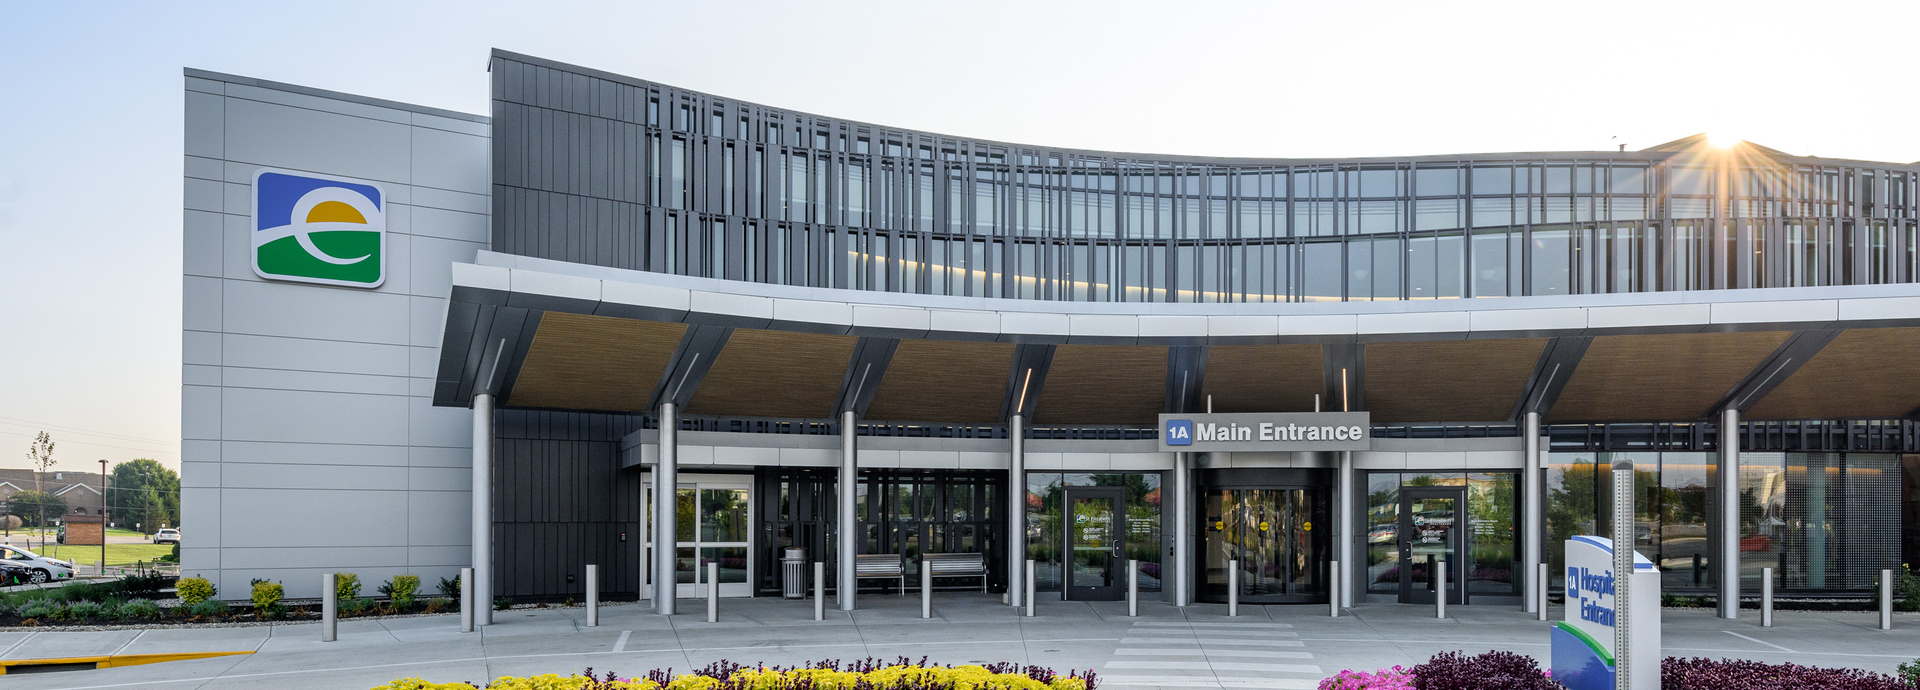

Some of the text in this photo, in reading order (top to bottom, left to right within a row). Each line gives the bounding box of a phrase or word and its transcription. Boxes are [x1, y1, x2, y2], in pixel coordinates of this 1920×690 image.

[1169, 423, 1363, 441] 1A Main Entrance
[1569, 575, 1577, 590] 1A
[1581, 567, 1615, 599] Hospita
[1581, 597, 1615, 628] Entran
